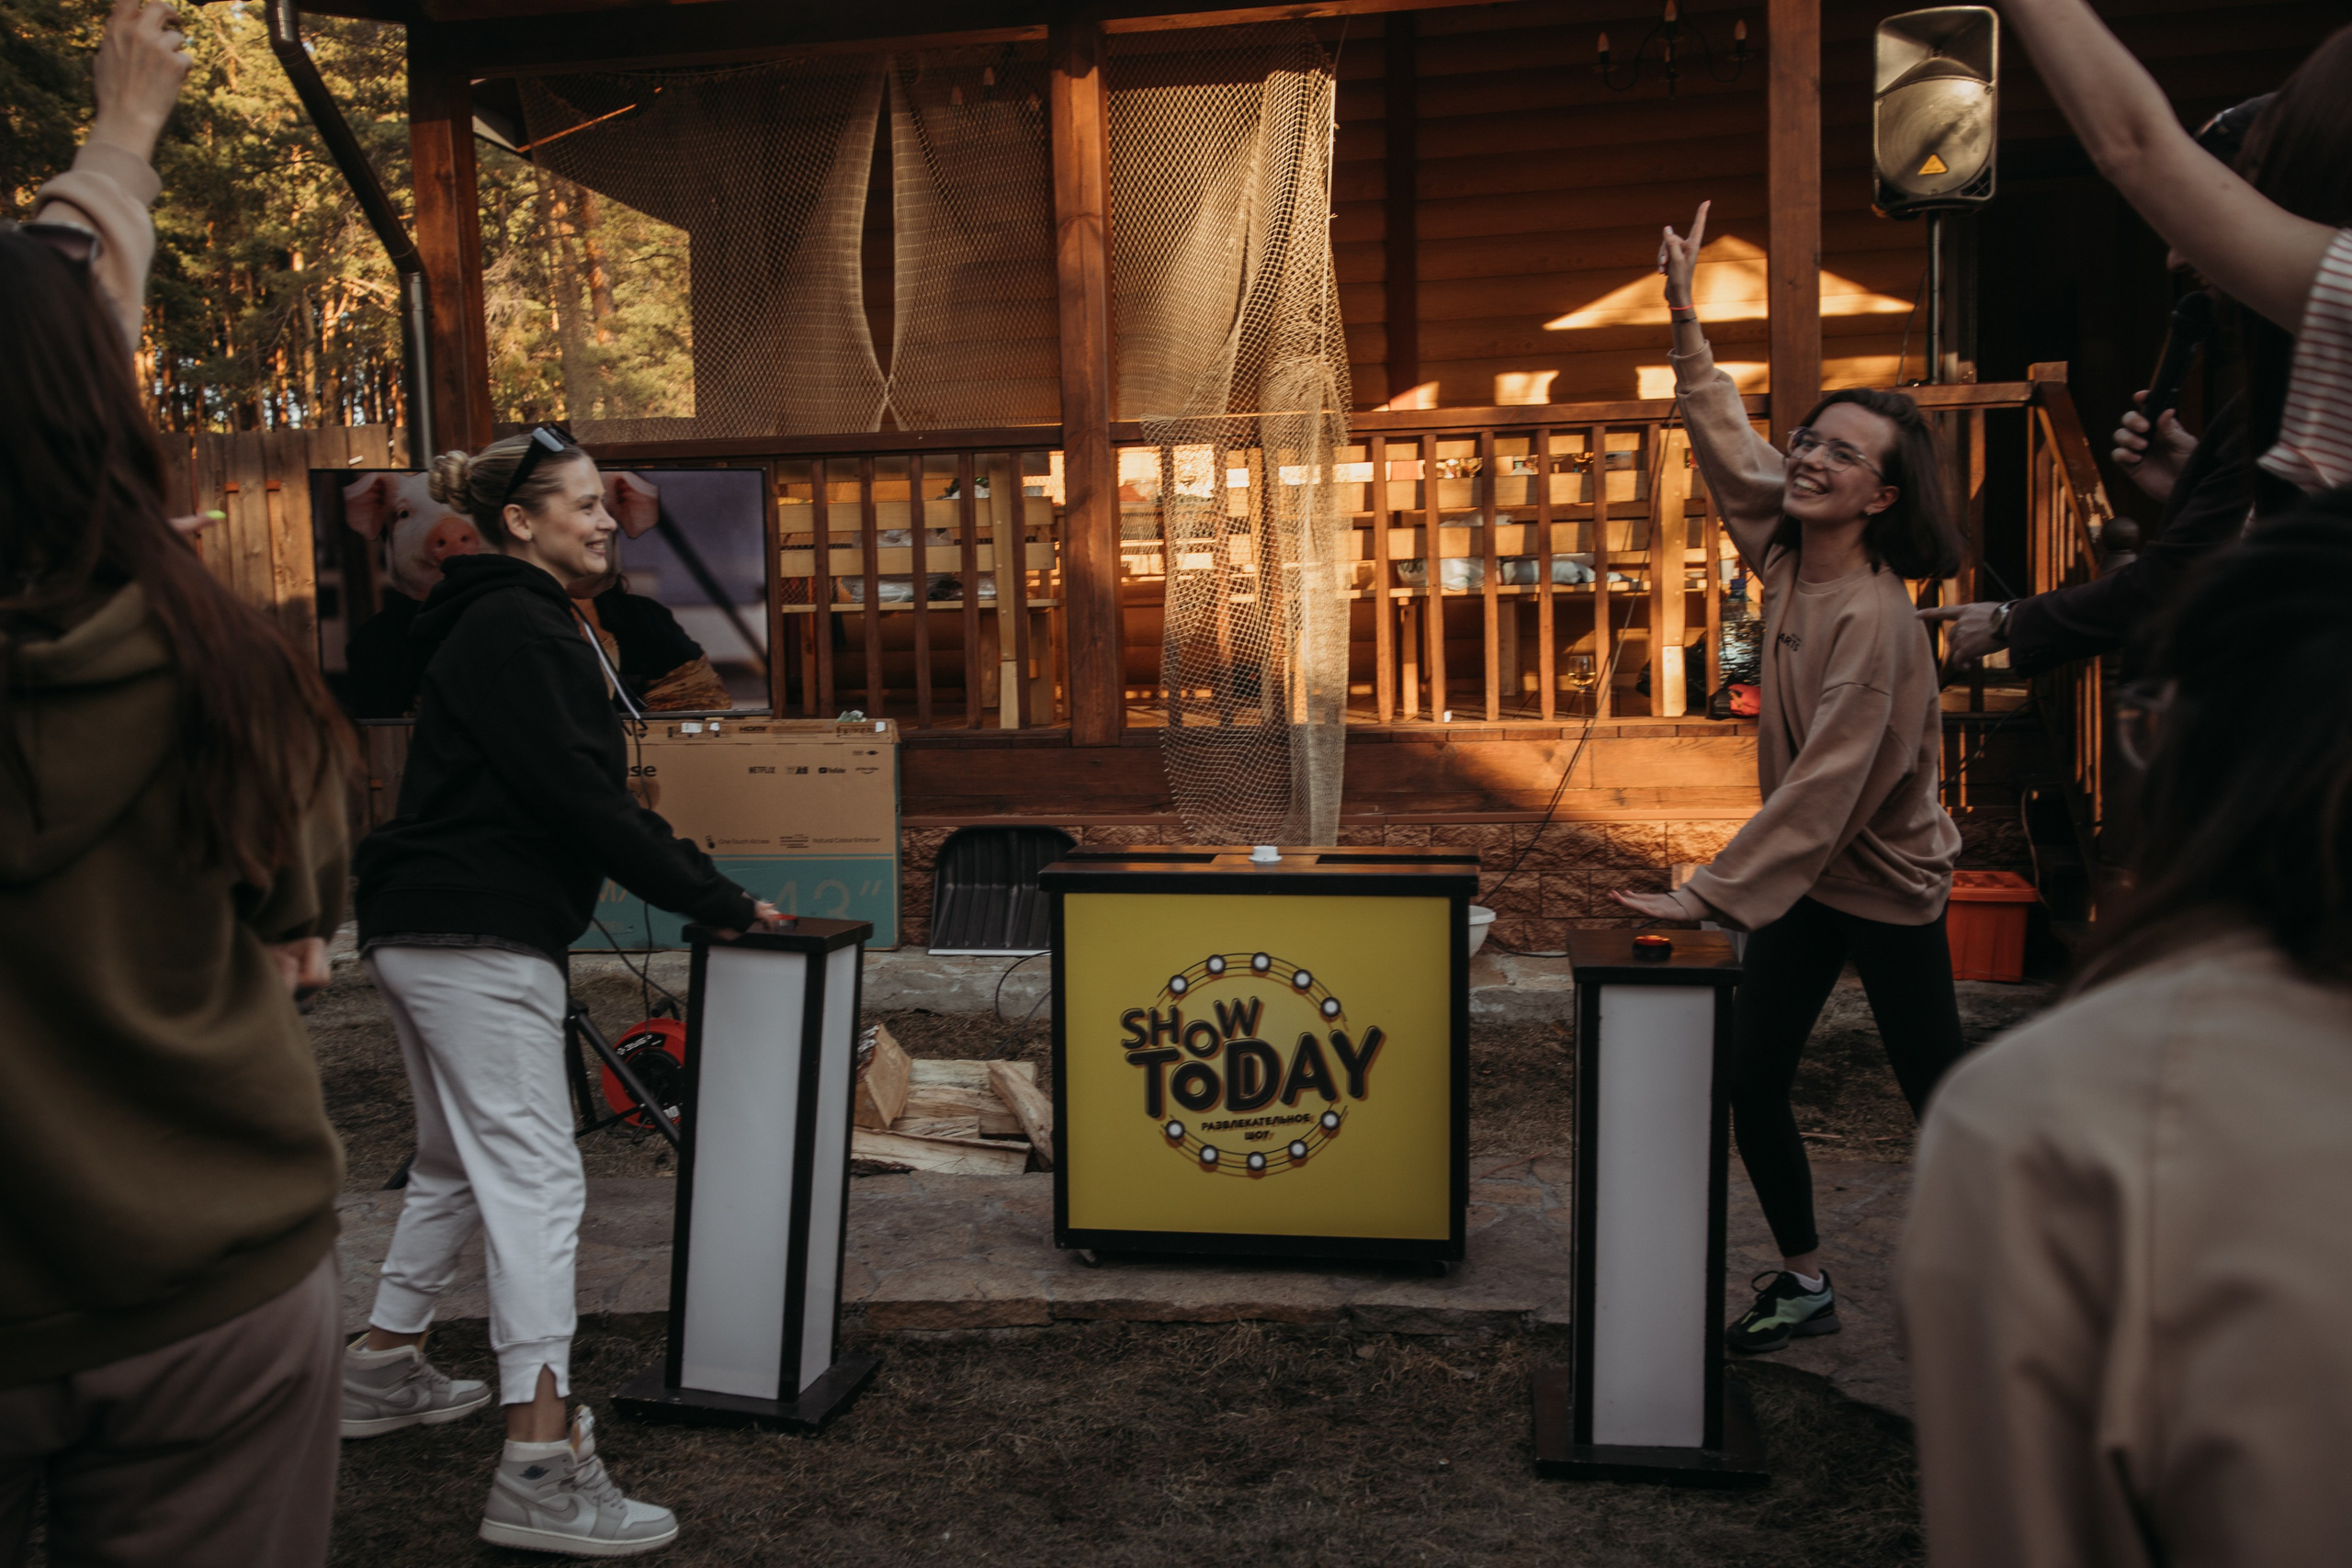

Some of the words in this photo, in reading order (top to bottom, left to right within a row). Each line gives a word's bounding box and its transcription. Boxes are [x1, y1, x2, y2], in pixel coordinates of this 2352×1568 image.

[748, 766, 775, 774] NETFLIX
[1120, 996, 1264, 1058] SHOW
[1201, 1113, 1312, 1131] РАЗВЛЕКАТЕЛЬНОЕ
[1244, 1130, 1272, 1141] ШОУ
